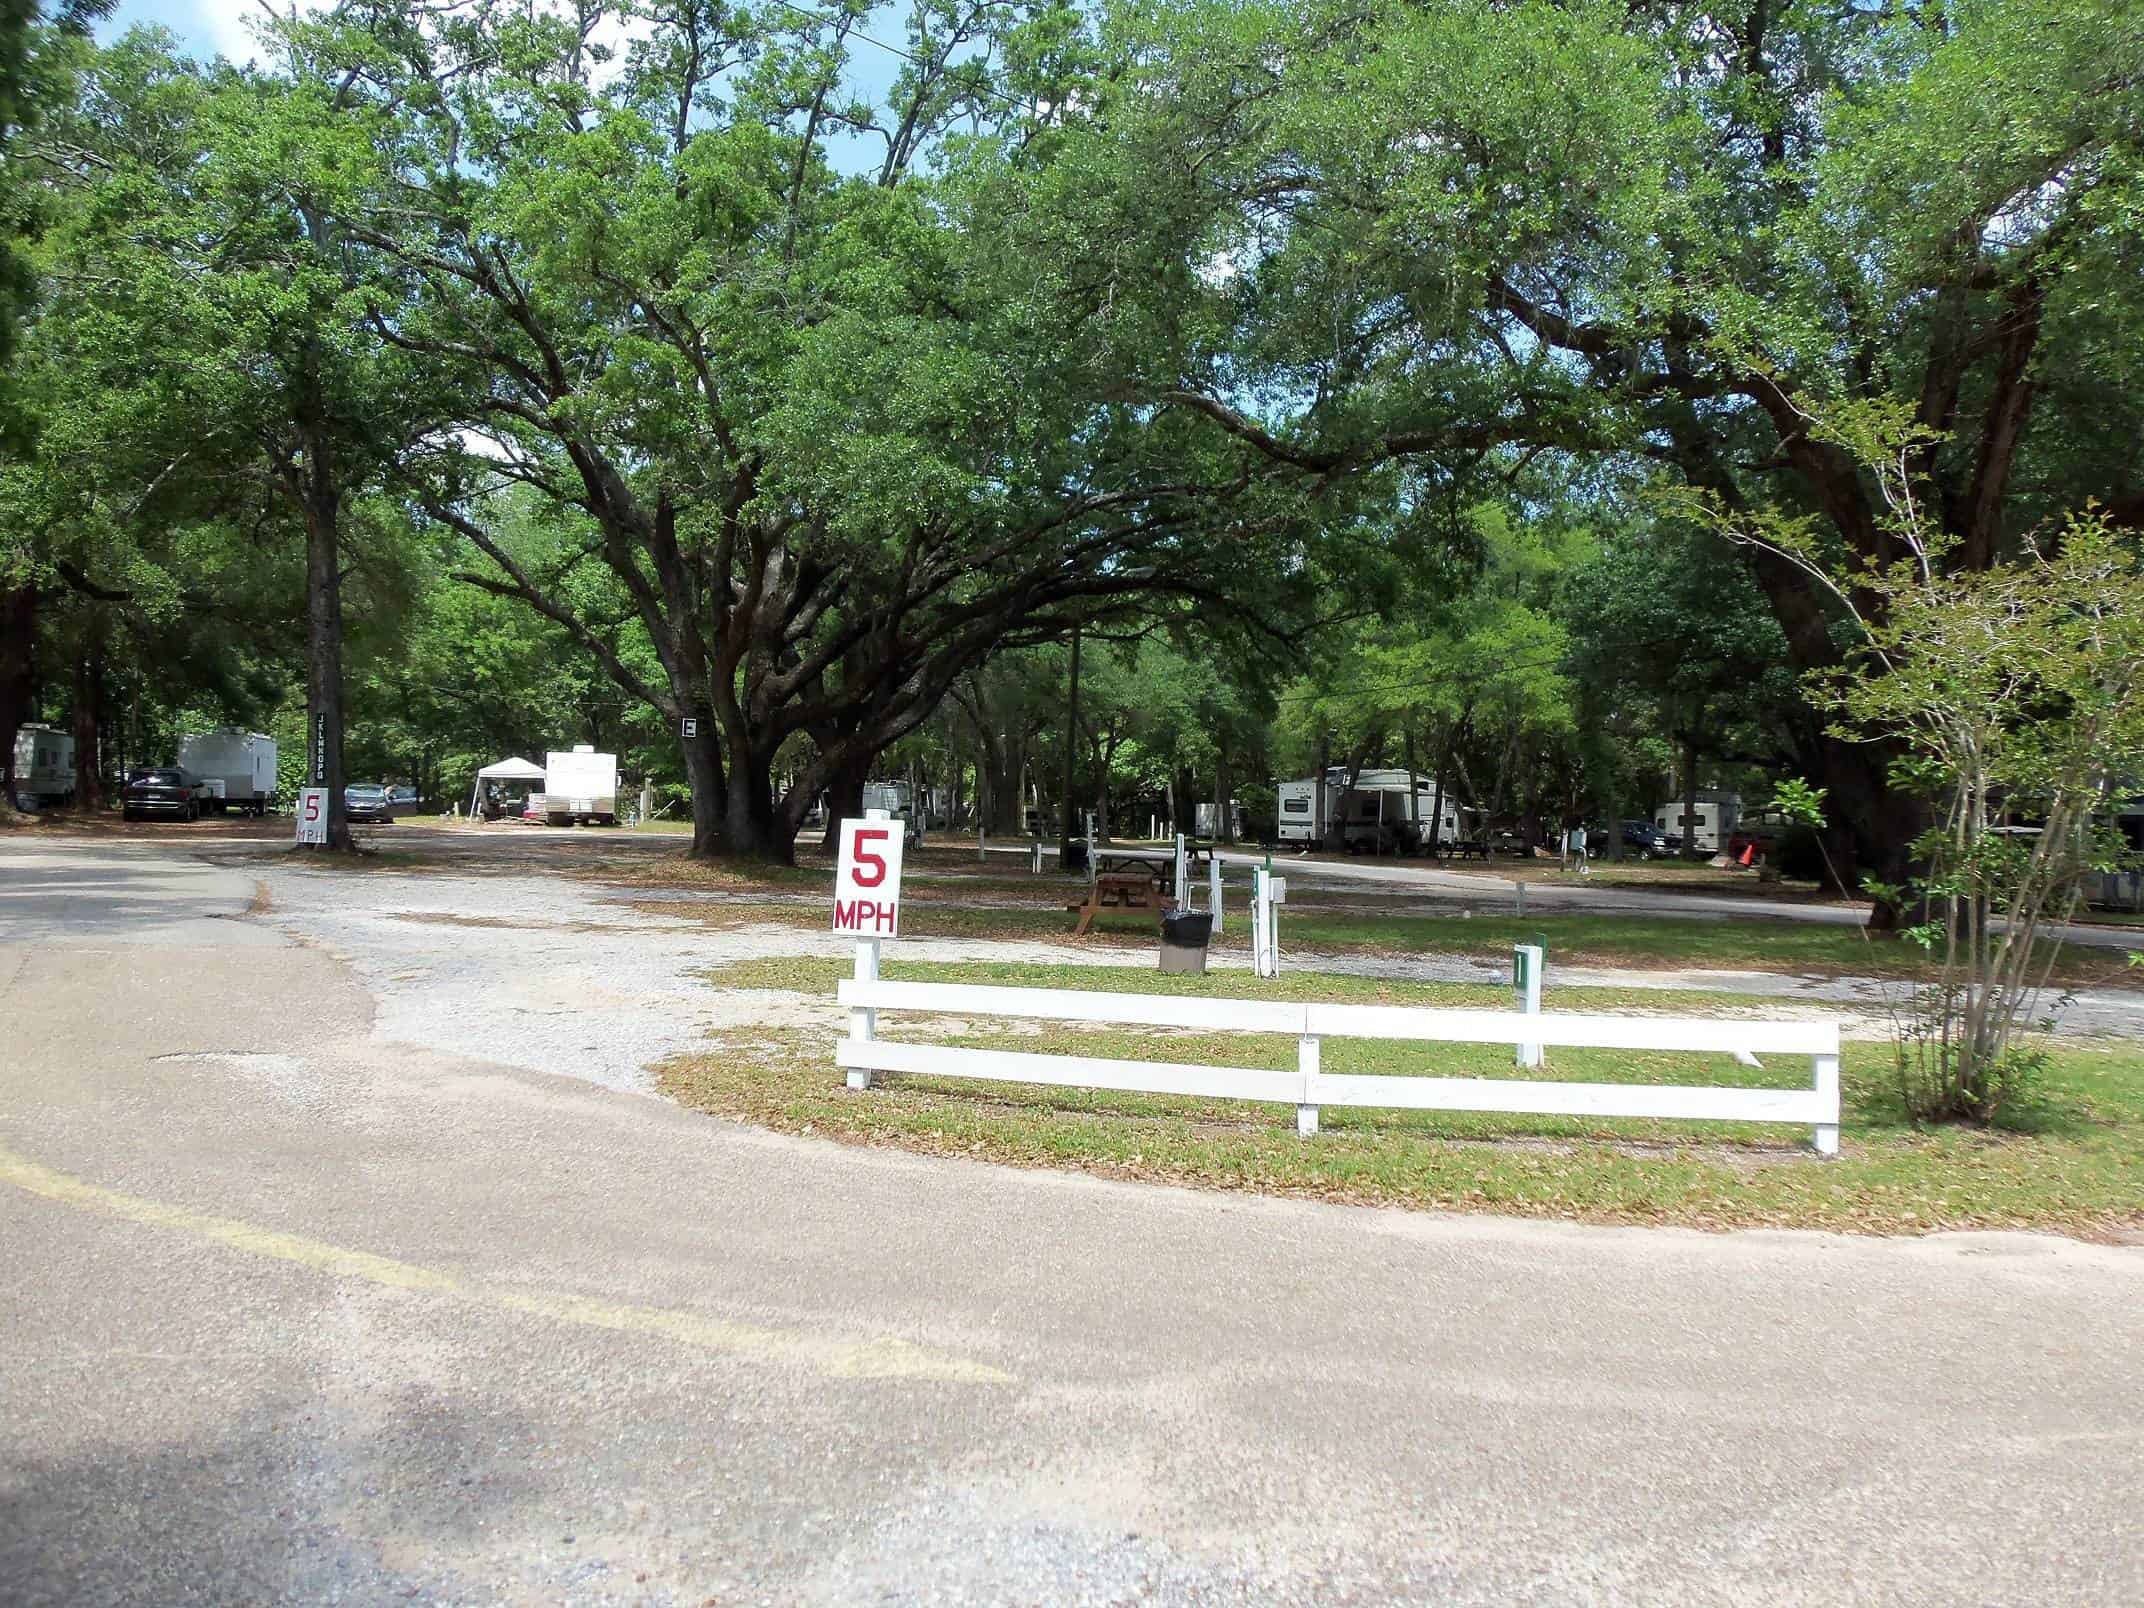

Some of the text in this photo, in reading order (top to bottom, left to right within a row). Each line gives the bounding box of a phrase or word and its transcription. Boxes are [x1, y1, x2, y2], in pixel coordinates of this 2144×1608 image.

[684, 719, 696, 736] E
[305, 795, 320, 821] 5
[297, 829, 323, 842] MPH
[852, 830, 888, 888] 5
[834, 900, 895, 933] MPH
